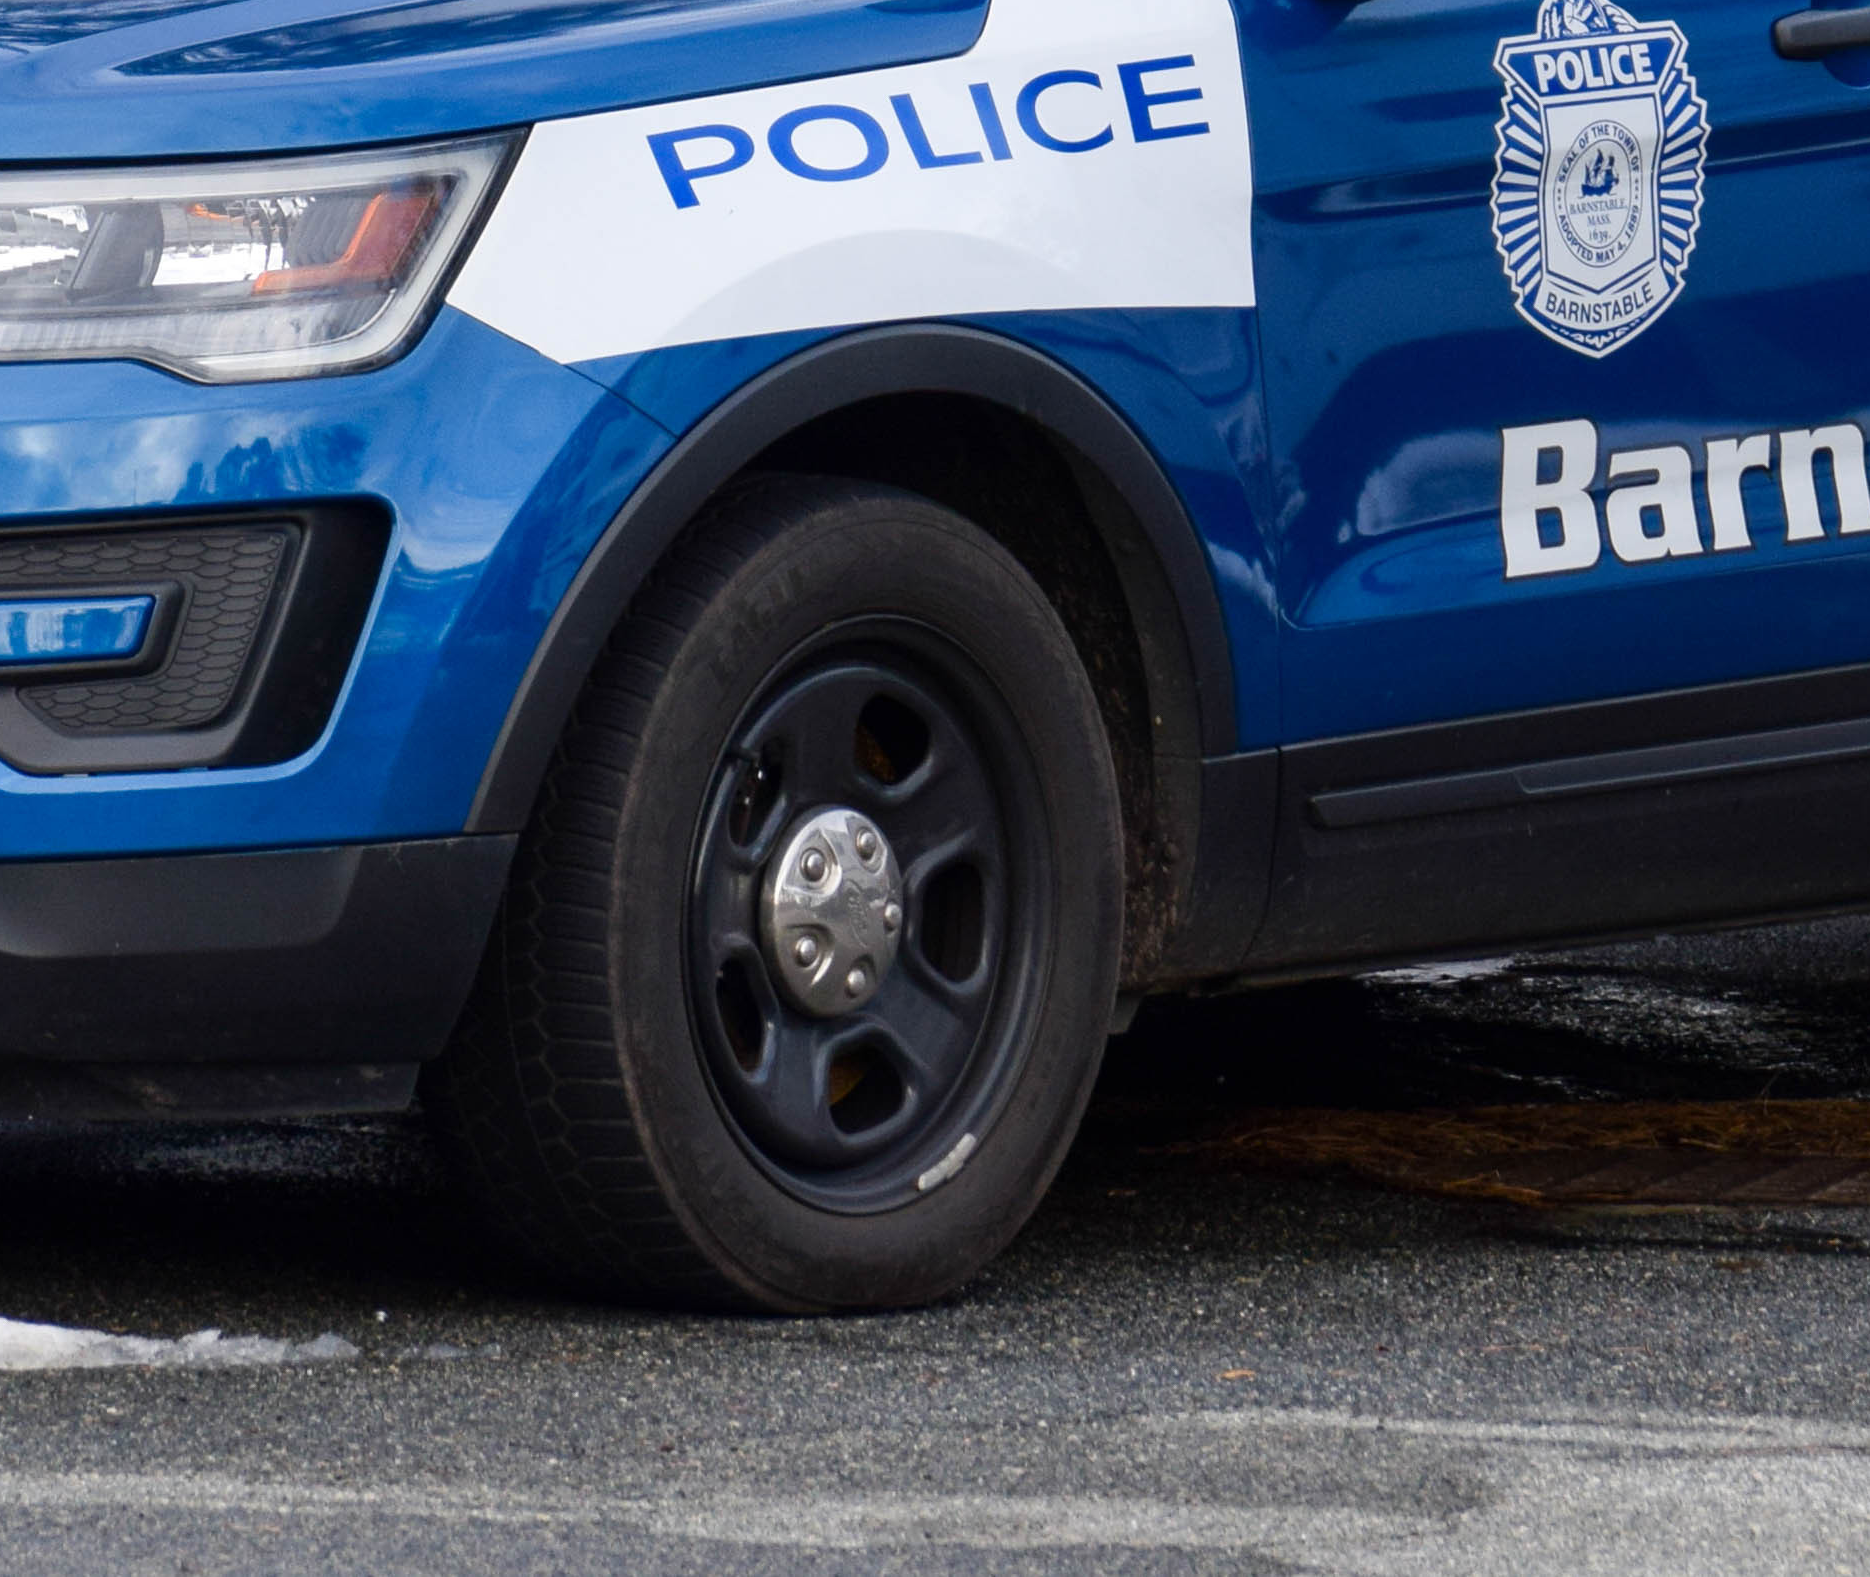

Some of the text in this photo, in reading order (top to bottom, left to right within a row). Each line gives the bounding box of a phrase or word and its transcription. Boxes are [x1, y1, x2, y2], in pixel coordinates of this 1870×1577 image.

[1533, 43, 1656, 93] POLICE
[645, 54, 1210, 210] POLICE
[1558, 124, 1640, 184] SEAL OF THE TOWN OF
[1558, 214, 1594, 262] ADOPTED
[1595, 247, 1616, 263] MAY
[1545, 280, 1655, 324] BARNSTABLE
